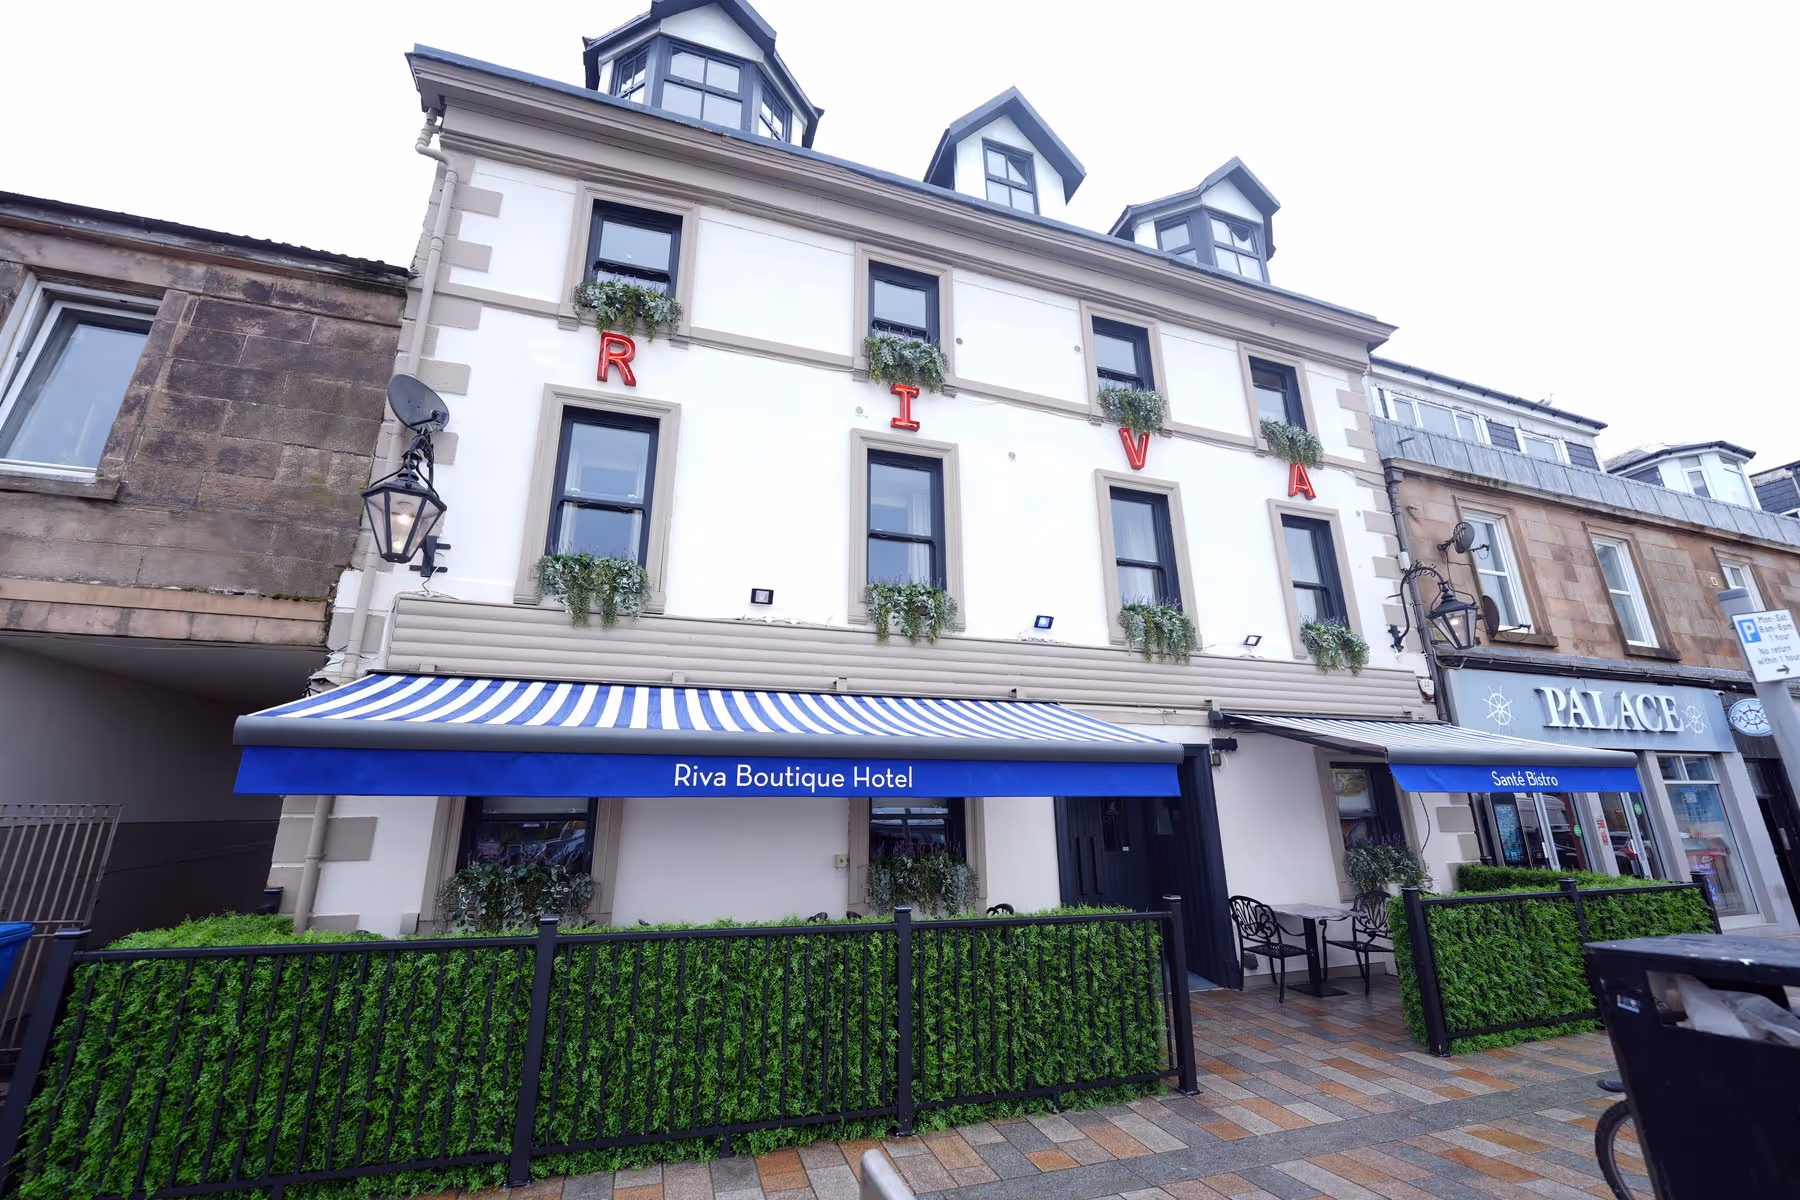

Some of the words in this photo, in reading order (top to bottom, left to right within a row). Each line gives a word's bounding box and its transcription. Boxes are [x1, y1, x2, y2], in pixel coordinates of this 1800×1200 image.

[1741, 622, 1756, 641] P
[1757, 656, 1778, 665] within
[1537, 686, 1685, 733] PALACE
[1730, 712, 1768, 724] PALAC
[674, 763, 727, 787] Riva
[736, 764, 845, 793] Boutique
[853, 765, 913, 788] Hotel
[1491, 770, 1526, 786] Santé
[1525, 771, 1559, 786] Bistro
